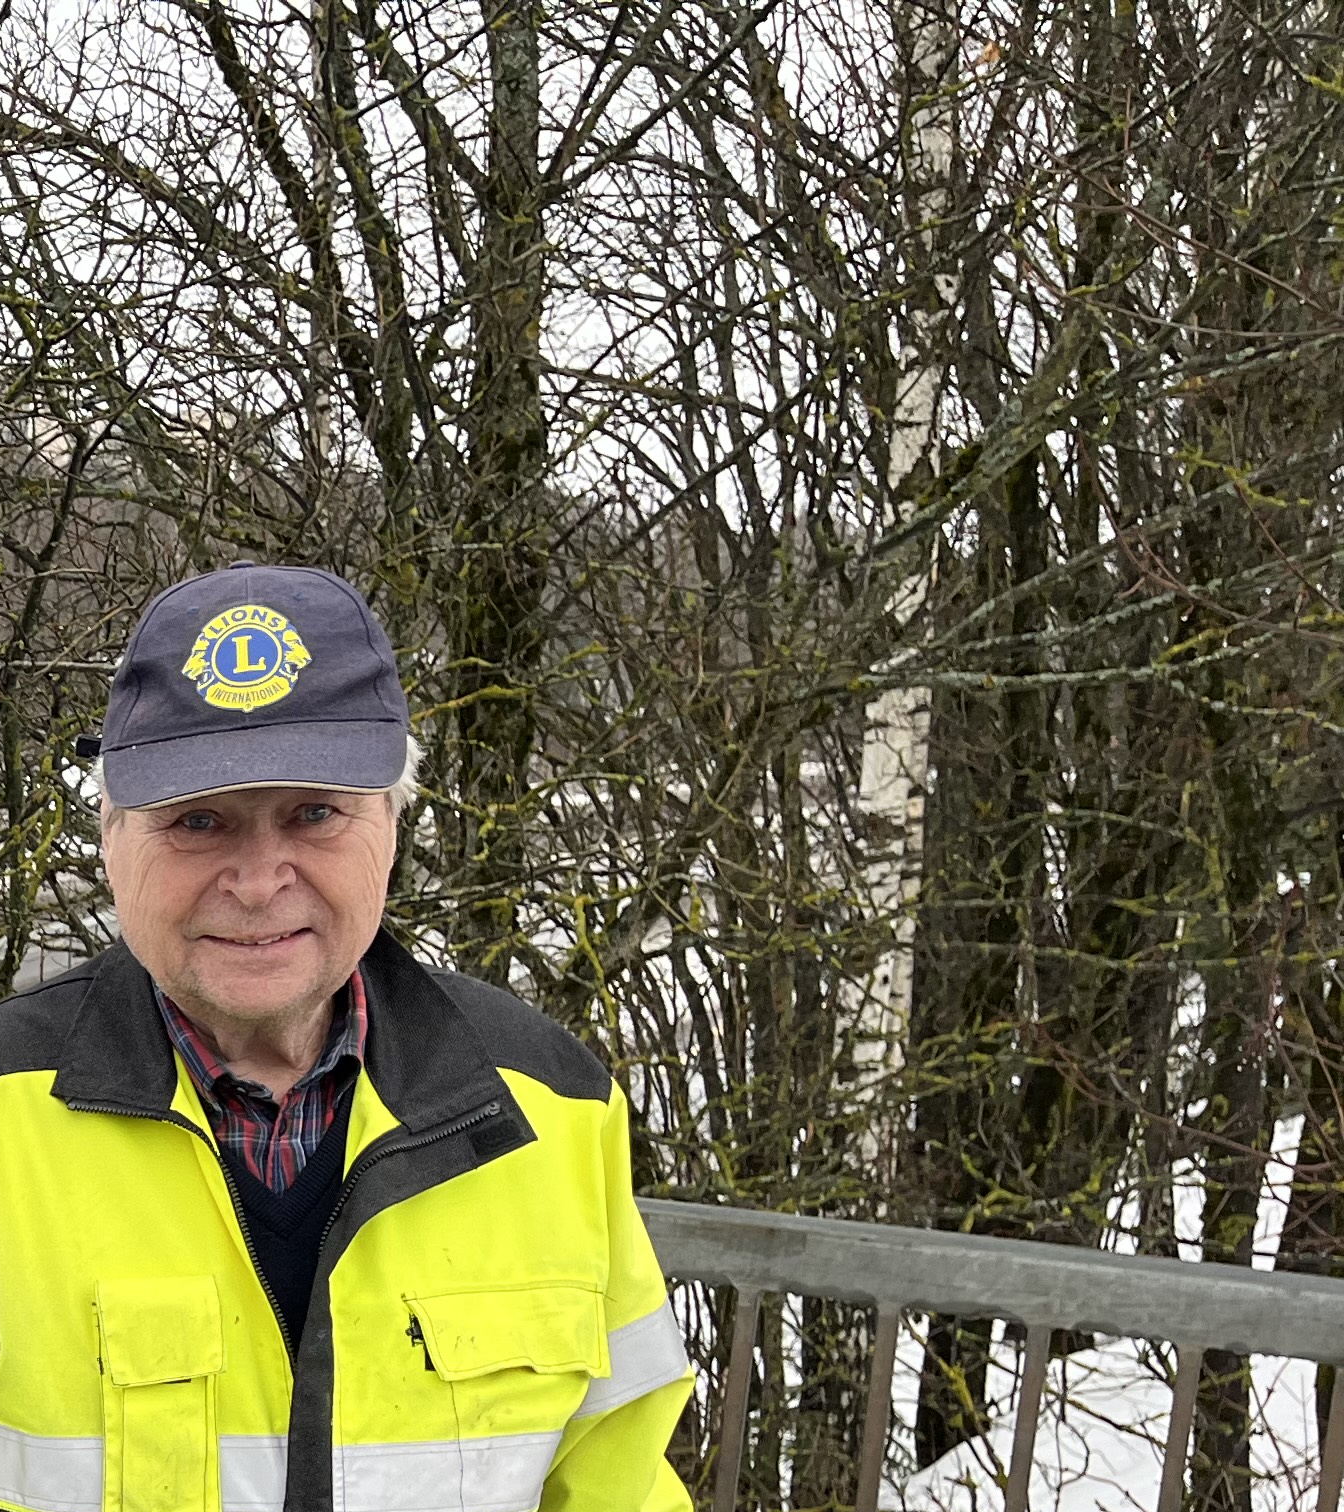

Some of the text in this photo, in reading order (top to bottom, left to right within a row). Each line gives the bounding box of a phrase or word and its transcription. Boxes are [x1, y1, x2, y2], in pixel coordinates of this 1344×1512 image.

[210, 609, 281, 637] LIONS
[232, 634, 267, 674] L
[211, 681, 285, 704] INTERNATIONAL
